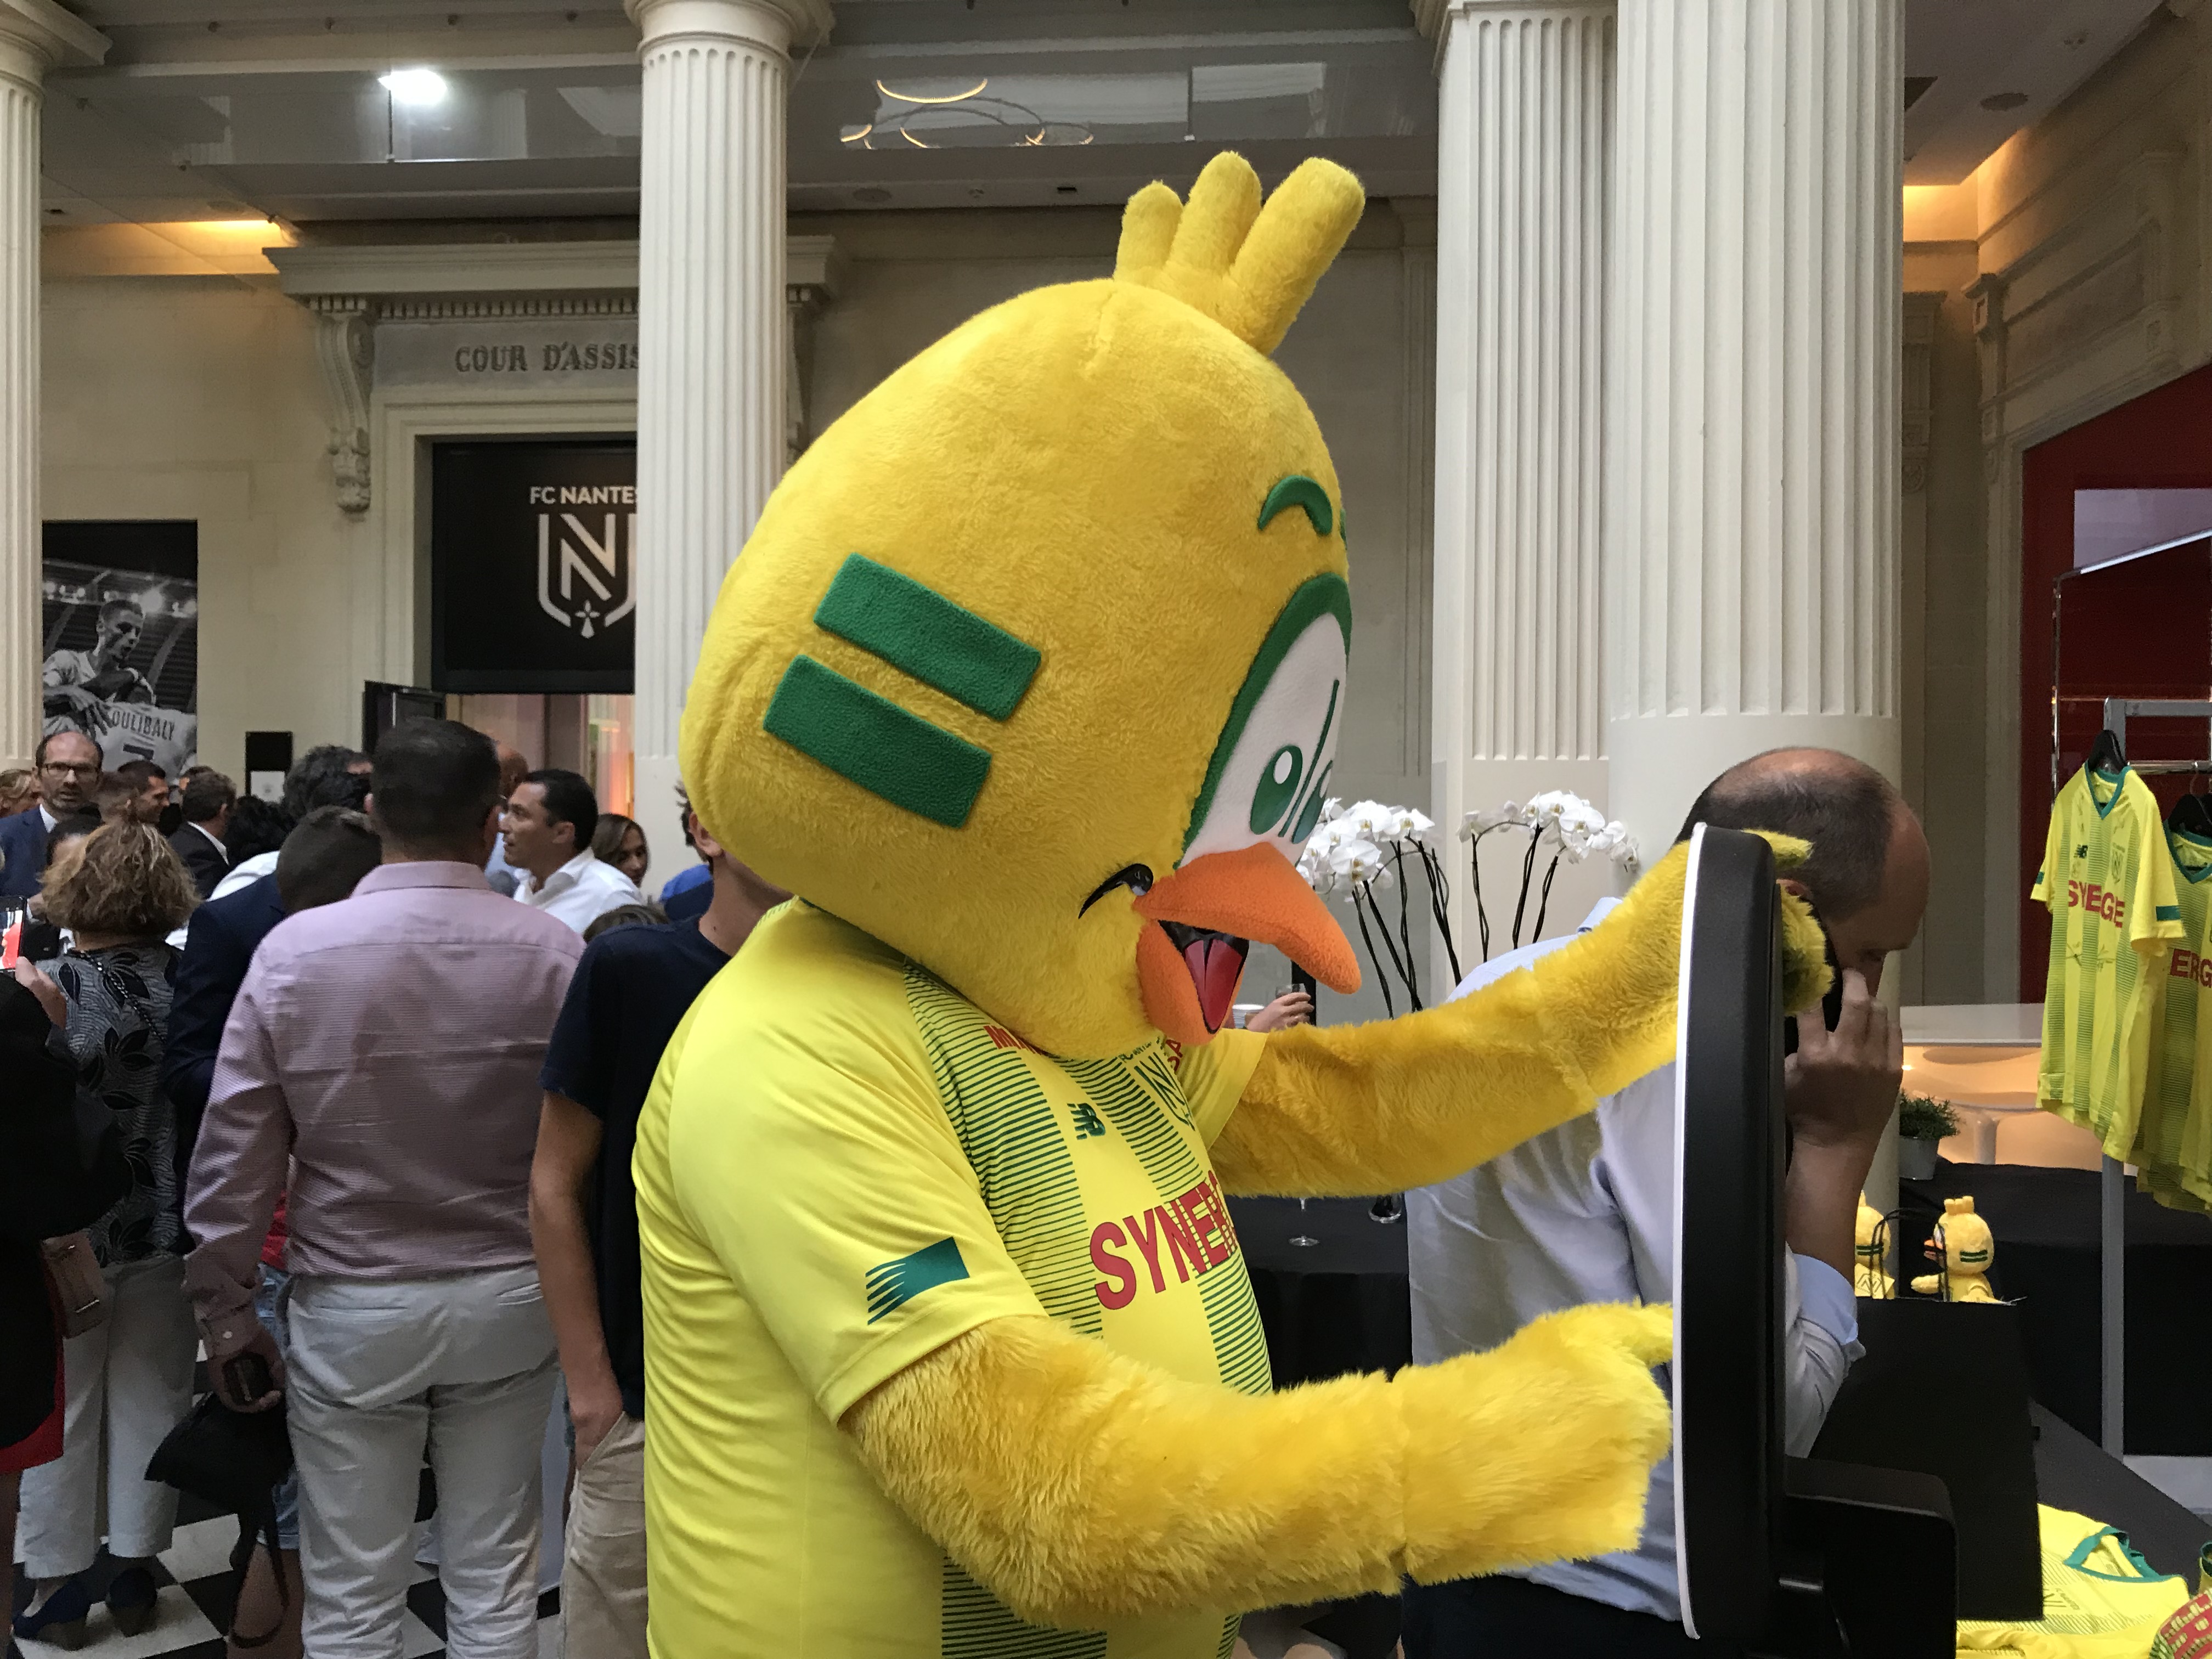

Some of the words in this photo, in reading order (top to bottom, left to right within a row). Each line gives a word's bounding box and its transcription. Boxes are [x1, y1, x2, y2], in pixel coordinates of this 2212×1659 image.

[455, 345, 528, 372] COUR
[530, 486, 556, 504] FC
[560, 486, 637, 504] NANTE
[111, 710, 175, 741] OULIBALY
[1090, 1170, 1238, 1310] SYNER
